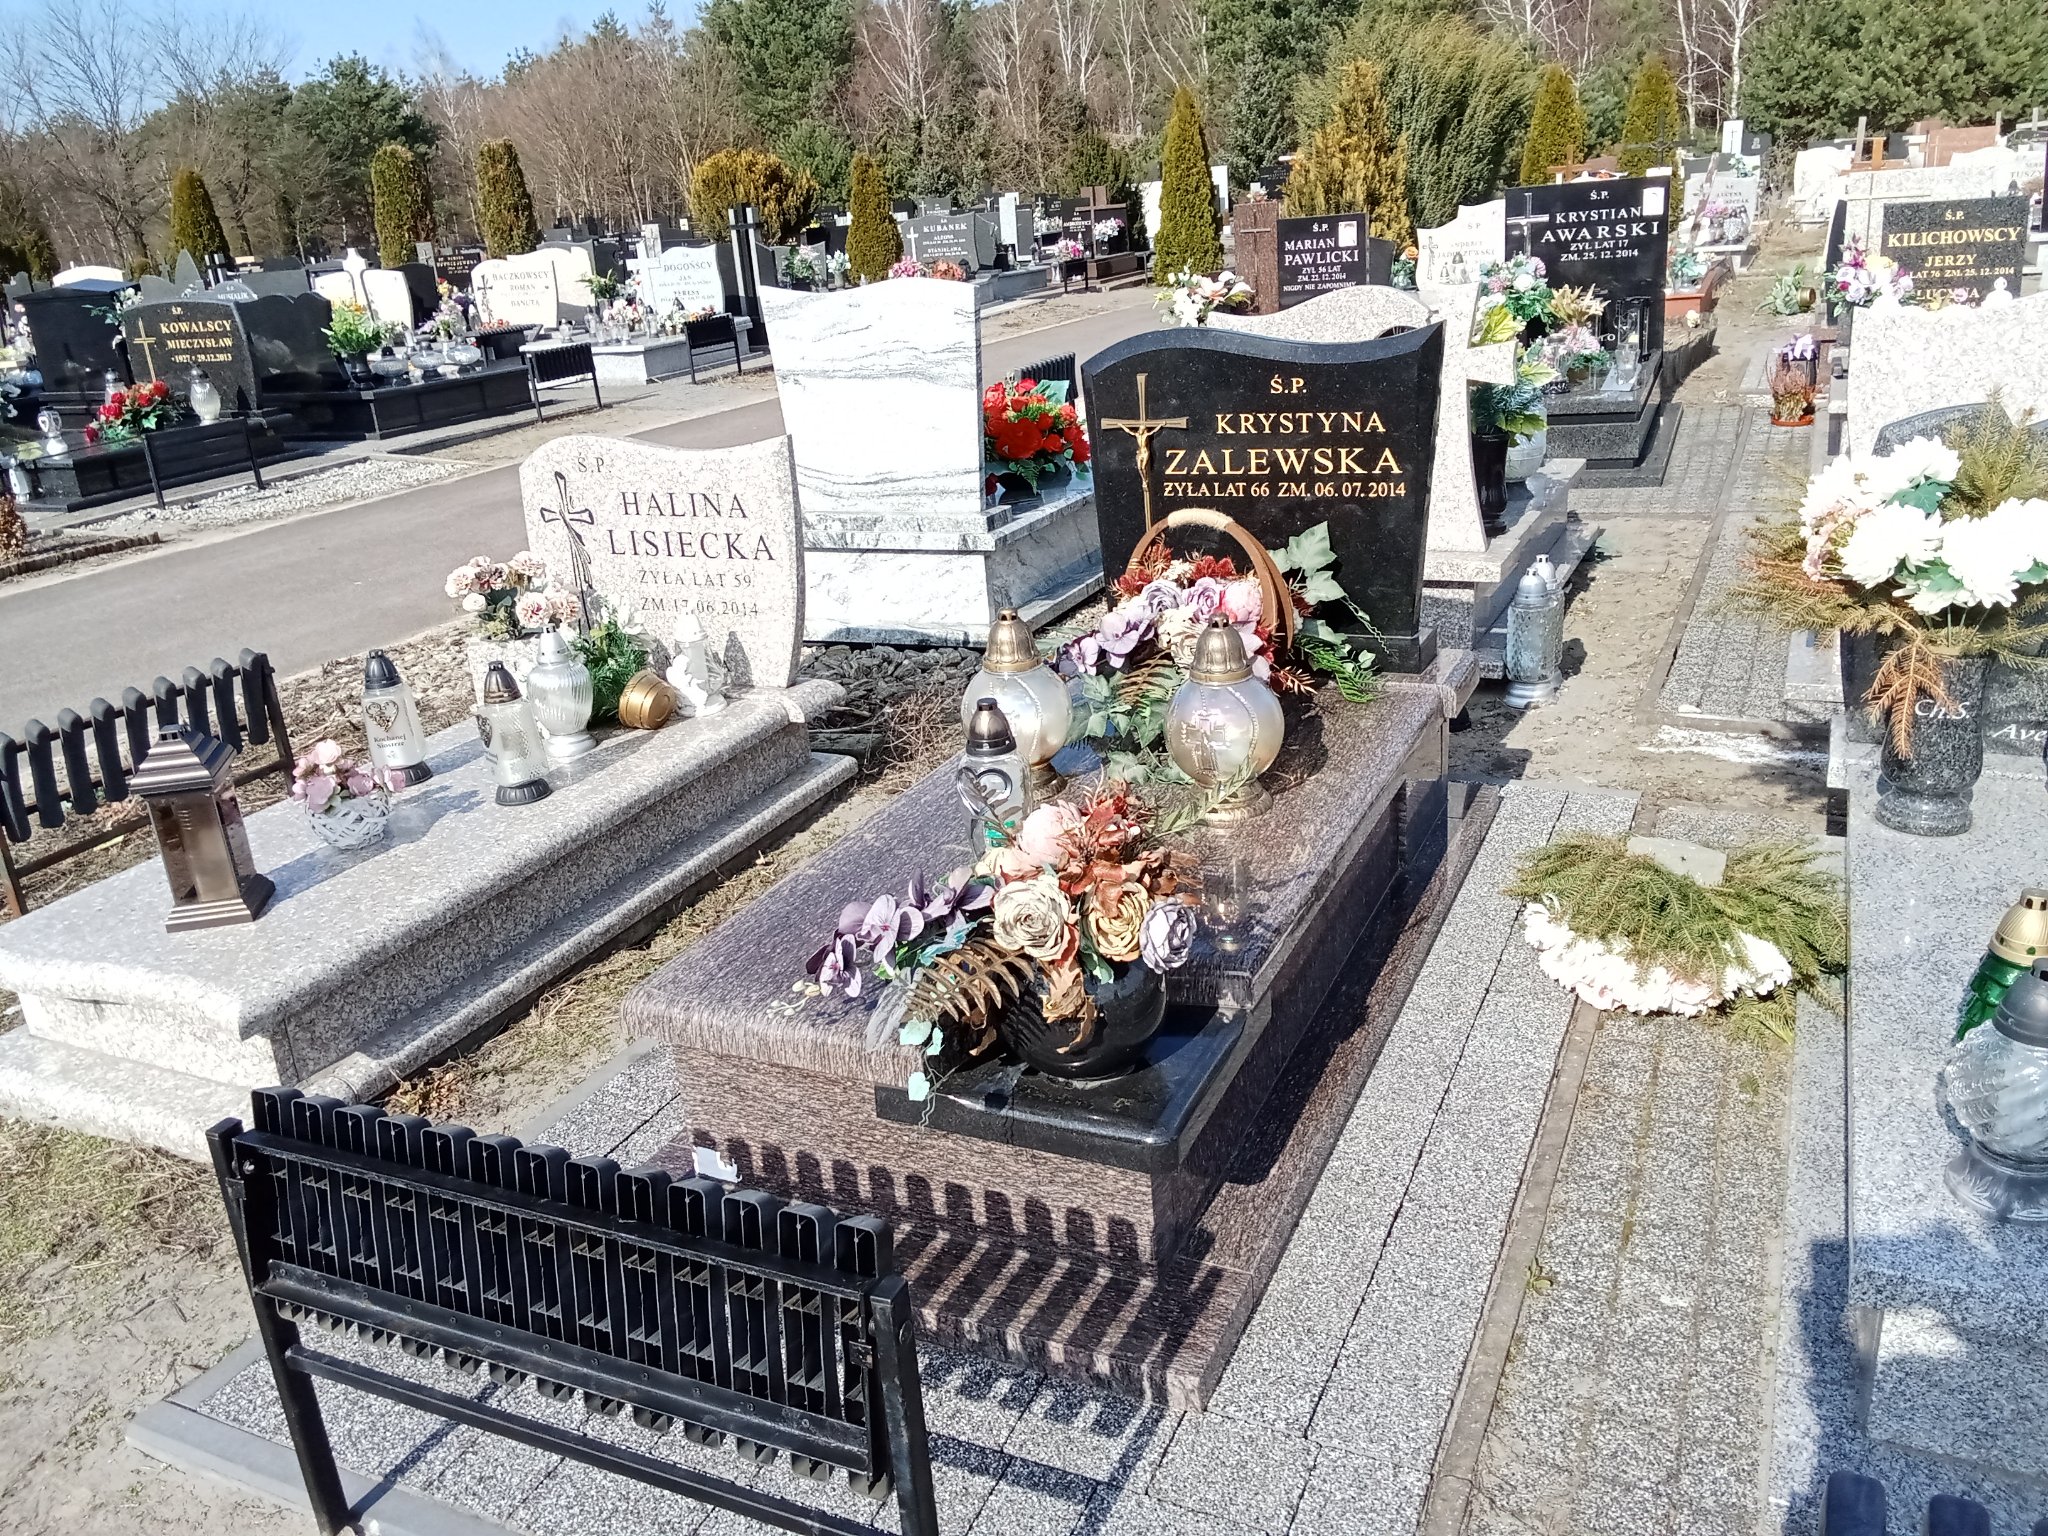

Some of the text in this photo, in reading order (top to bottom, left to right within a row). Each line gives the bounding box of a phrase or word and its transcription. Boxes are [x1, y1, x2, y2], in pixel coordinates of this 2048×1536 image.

[1556, 206, 1641, 224] KRYSTIAN
[923, 222, 967, 232] KUBANEK
[1541, 221, 1660, 243] AWARSKI
[1284, 238, 1335, 251] MARIAN
[1595, 240, 1616, 250] LAT
[1618, 239, 1629, 248] 17
[1887, 226, 2022, 248] KILICHOWSCY
[1284, 250, 1359, 266] PAWLICKI
[1615, 248, 1639, 258] 2014
[1925, 253, 1977, 268] JERZY
[1910, 271, 1928, 279] LAT
[1930, 270, 1940, 278] 76
[1994, 267, 2014, 275] 2014
[160, 320, 232, 334] KOWALSCY
[166, 338, 233, 350] MIECZYSŁAW
[1270, 374, 1307, 394] Ś.P.
[1216, 411, 1386, 434] KRYSTYNA
[1164, 447, 1403, 475] ZALEWSKA
[1213, 482, 1246, 497] LAT
[1250, 482, 1270, 497] 66
[1277, 482, 1310, 497] ZM.
[1368, 482, 1406, 497] 2014
[620, 491, 748, 519] HALINA
[607, 529, 776, 561] LISIECKA
[692, 572, 725, 587] LAT
[734, 573, 752, 588] 59
[1992, 723, 2048, 741] Ave
